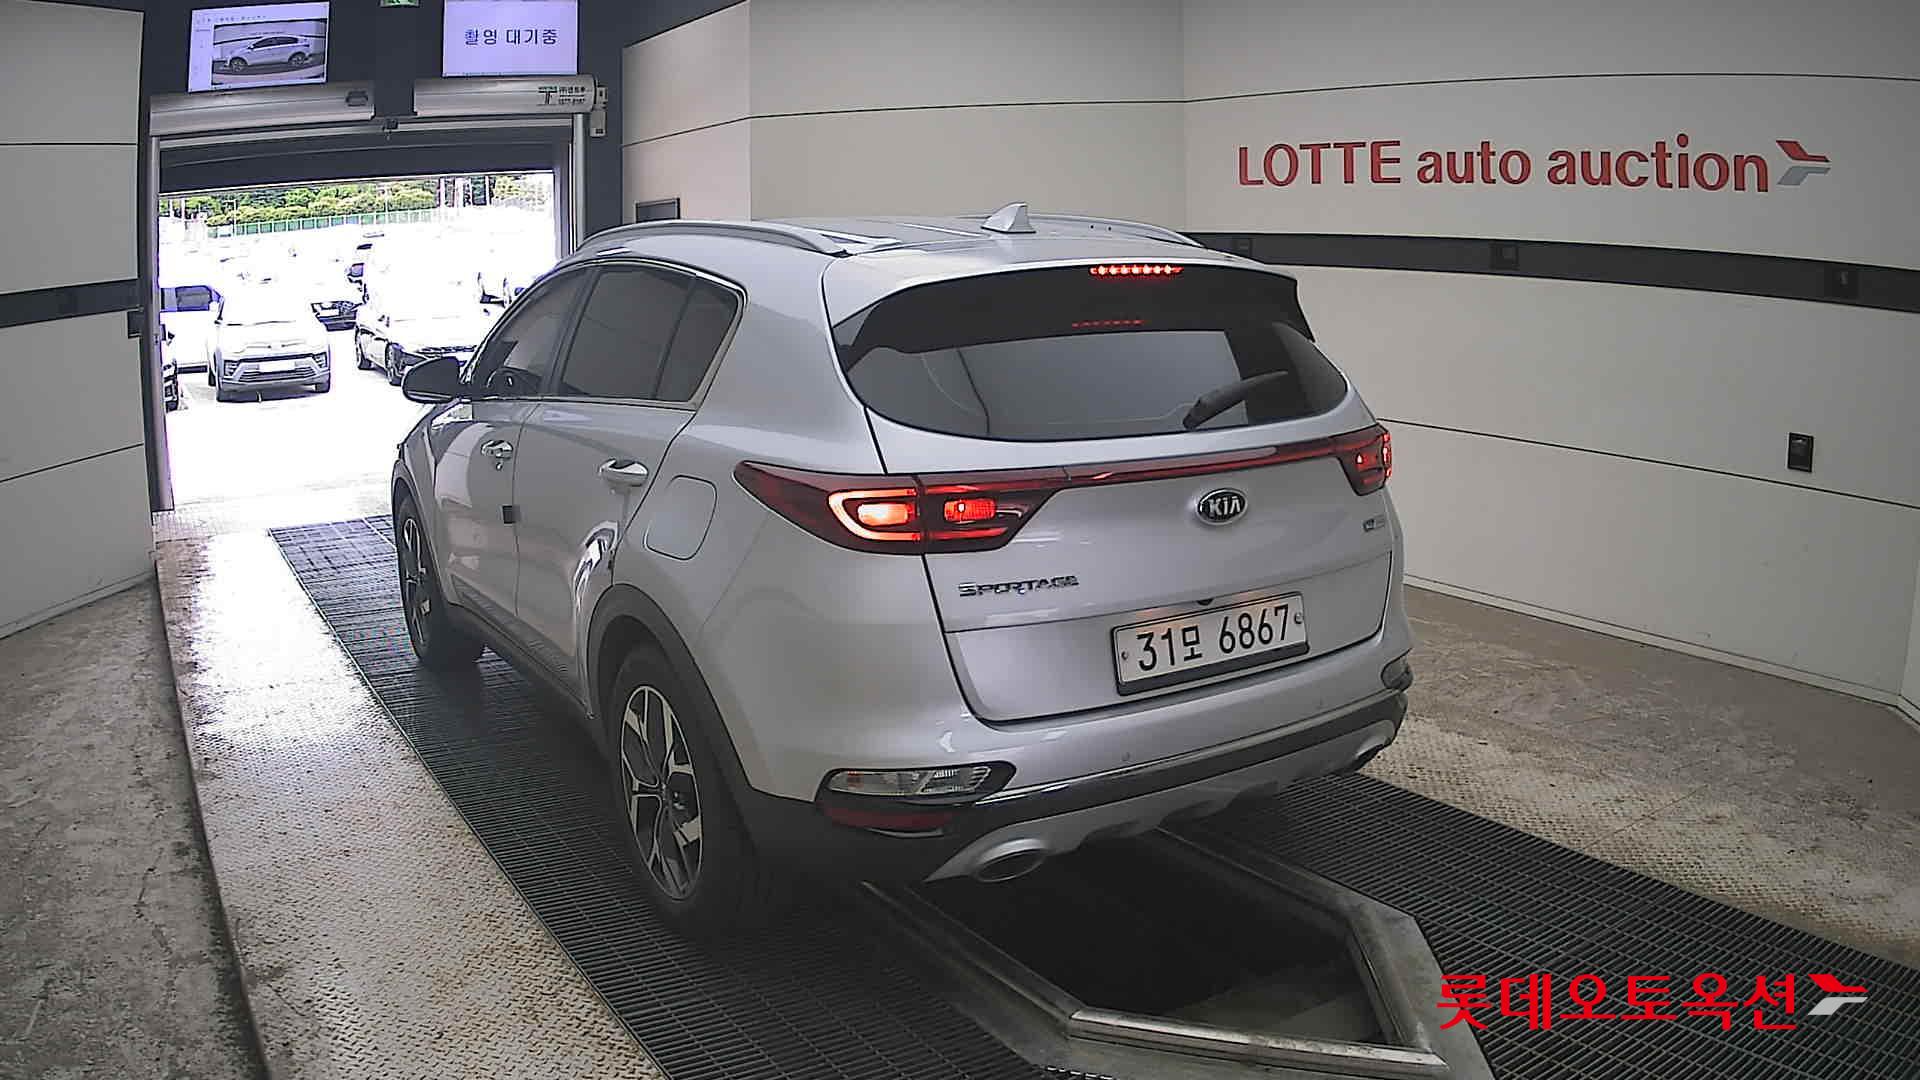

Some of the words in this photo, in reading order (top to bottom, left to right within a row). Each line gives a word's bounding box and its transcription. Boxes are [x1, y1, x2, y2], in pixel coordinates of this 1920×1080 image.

[465, 28, 497, 45] 촬영
[506, 28, 558, 45] 대기중
[1238, 140, 1400, 186] LOTTE
[1416, 141, 1531, 185] auto
[1547, 133, 1768, 192] auction
[1209, 496, 1241, 516] KIA
[958, 575, 1079, 597] SPORTAGE
[1136, 625, 1203, 671] 31모
[1219, 604, 1289, 654] 6867
